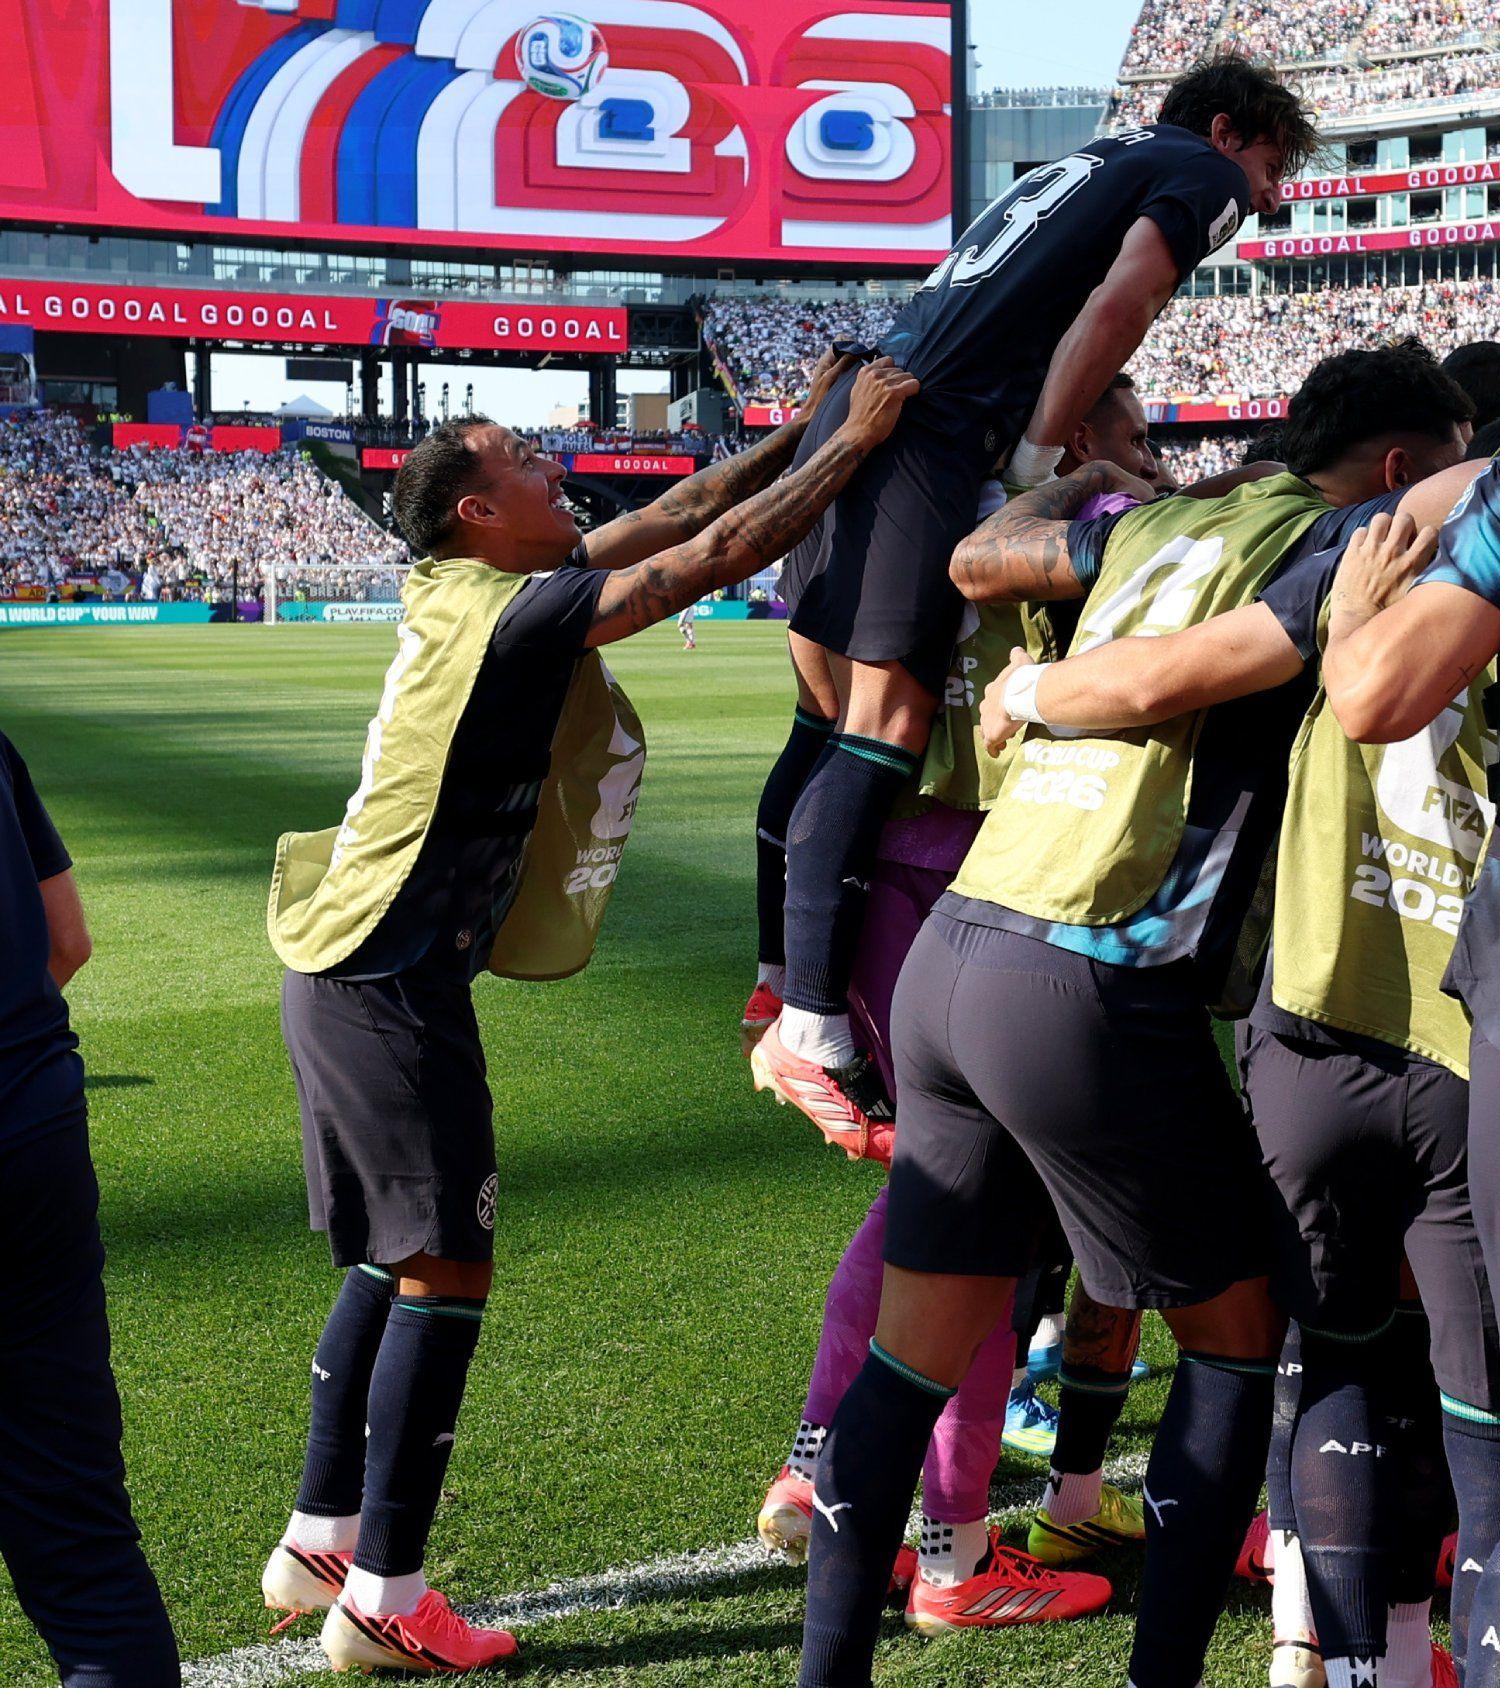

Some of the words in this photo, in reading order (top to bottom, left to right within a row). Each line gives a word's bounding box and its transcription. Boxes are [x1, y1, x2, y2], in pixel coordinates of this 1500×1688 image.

[1281, 179, 1367, 200] OOOAL
[1264, 235, 1368, 258] GOOOAL
[44, 296, 187, 323] GOOOAL
[200, 304, 338, 330] GOOOAL
[493, 316, 622, 340] GOOOAL
[305, 425, 350, 440] BOSTON
[613, 458, 669, 471] GOOOAL
[8, 606, 56, 621] WORLD
[92, 606, 127, 621] YOUR
[127, 606, 159, 621] WAY
[1010, 767, 1107, 811] 2026
[1421, 784, 1487, 840] FIFA
[1361, 832, 1464, 888] WORLD
[565, 863, 617, 895] 20
[1351, 864, 1465, 937] 202
[1318, 1439, 1388, 1458] APF
